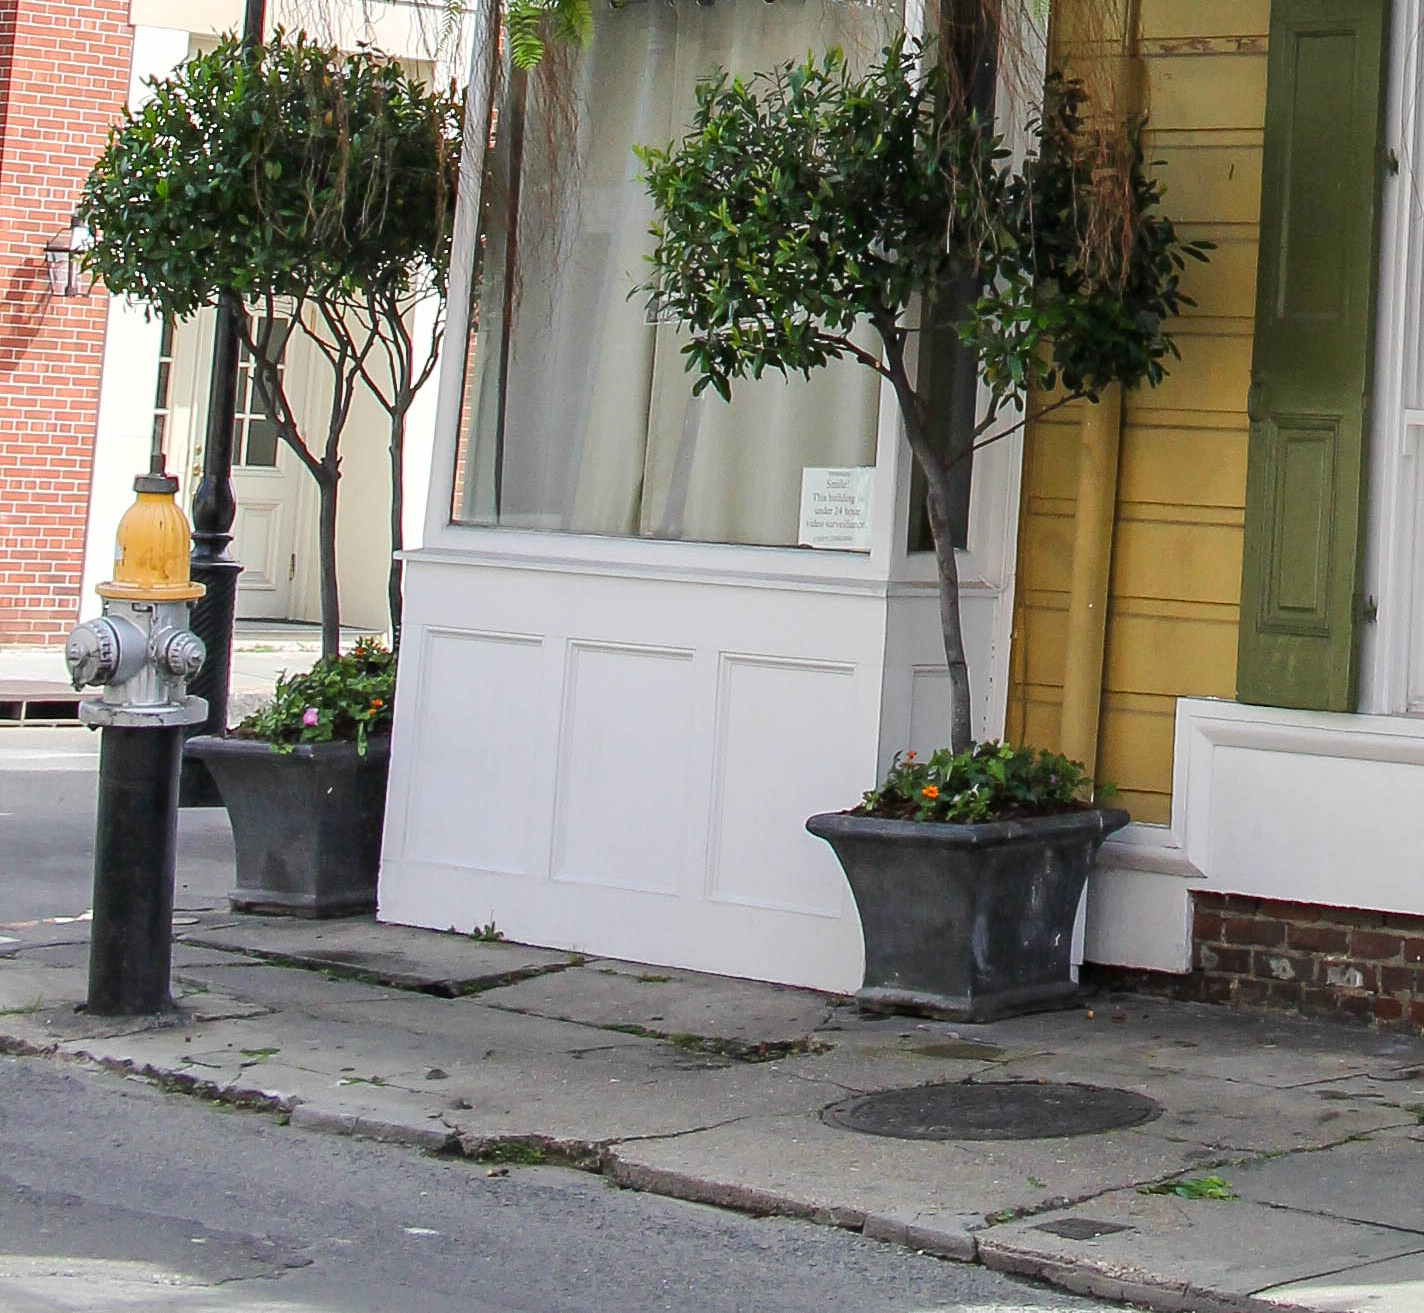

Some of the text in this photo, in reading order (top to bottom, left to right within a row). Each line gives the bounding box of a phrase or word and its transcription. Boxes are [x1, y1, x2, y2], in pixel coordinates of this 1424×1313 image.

[813, 493, 827, 503] This
[828, 493, 855, 505] building
[814, 506, 861, 516] under 24 hour
[806, 518, 824, 528] video
